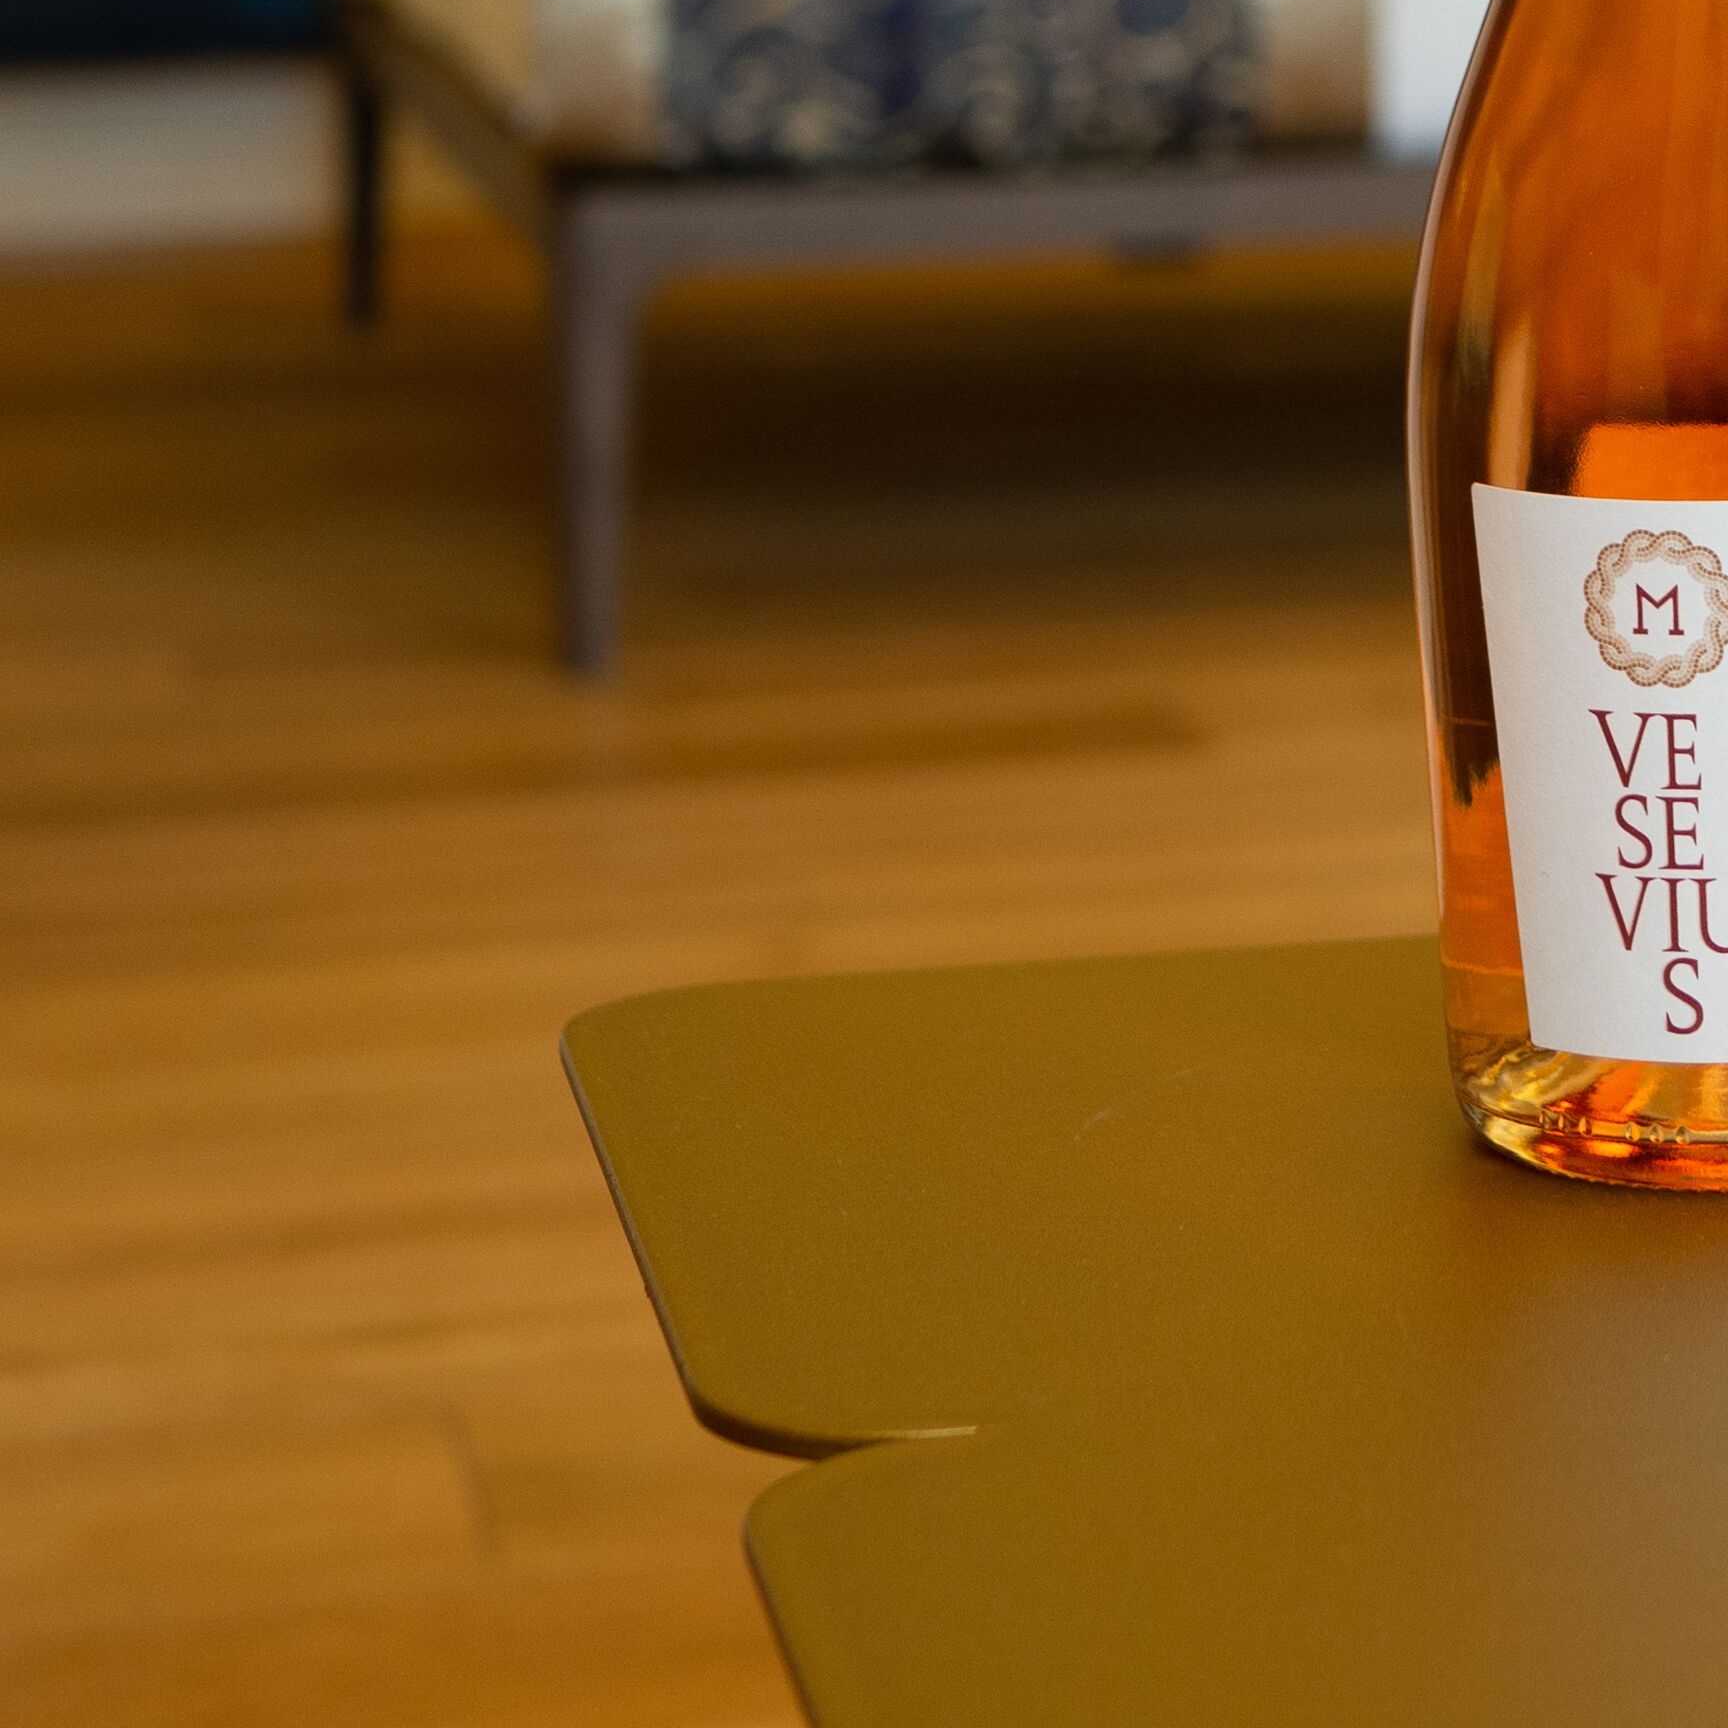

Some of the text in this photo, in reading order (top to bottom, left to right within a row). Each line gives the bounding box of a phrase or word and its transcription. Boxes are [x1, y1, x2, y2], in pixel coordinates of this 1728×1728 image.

[1632, 583, 1685, 636] M
[1588, 709, 1702, 790] VE
[1614, 794, 1705, 871] SE
[1661, 957, 1704, 1035] S
